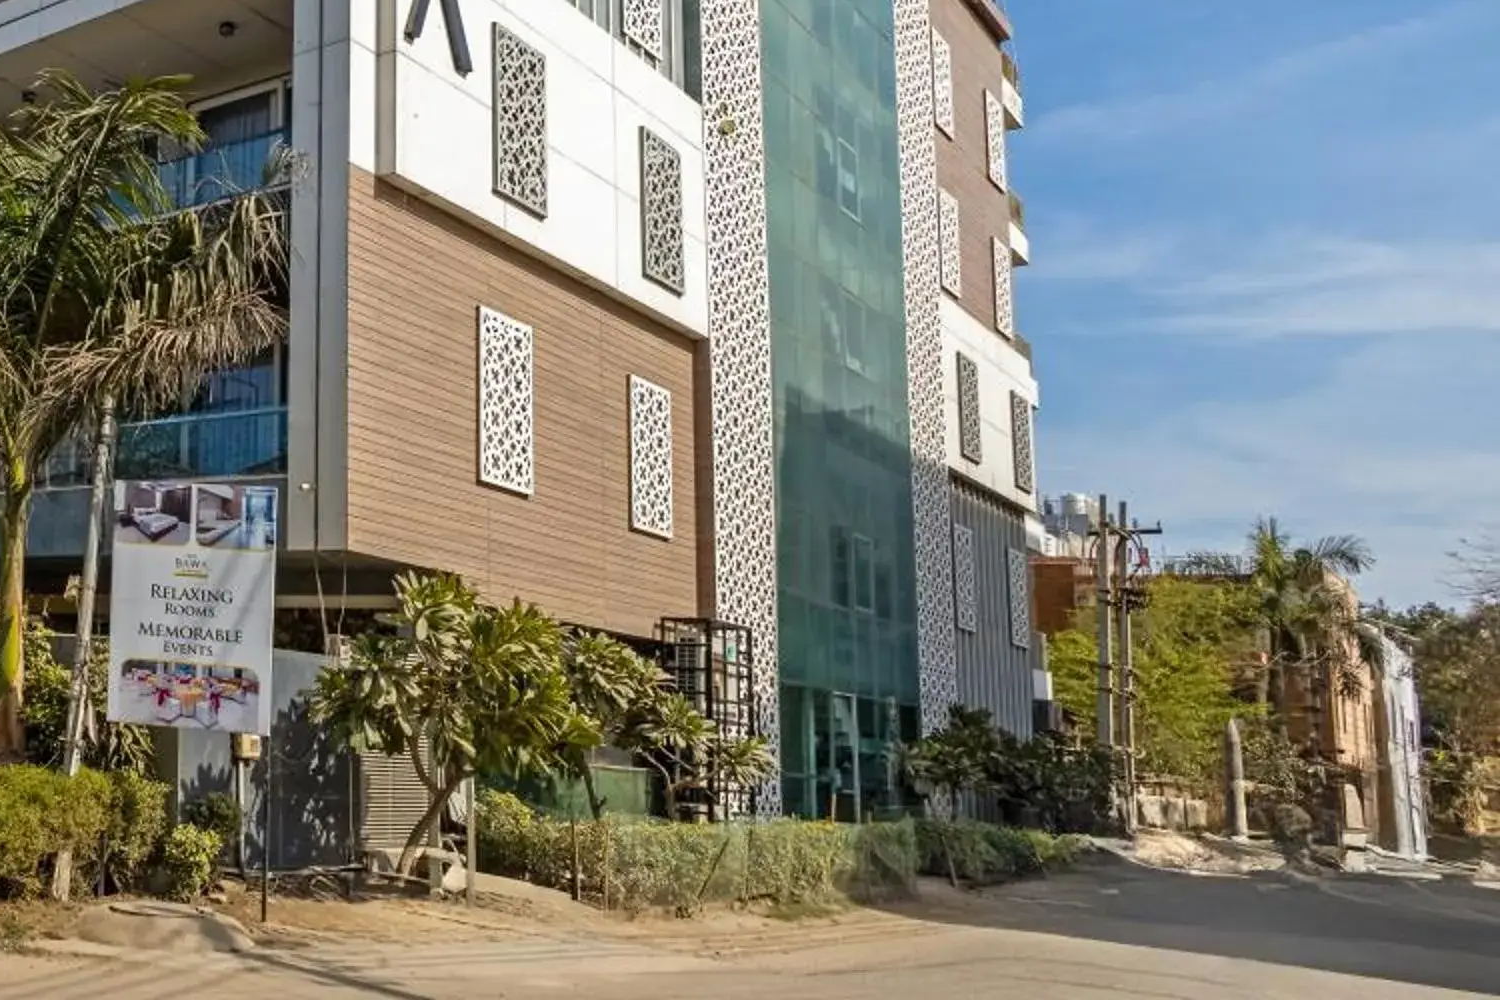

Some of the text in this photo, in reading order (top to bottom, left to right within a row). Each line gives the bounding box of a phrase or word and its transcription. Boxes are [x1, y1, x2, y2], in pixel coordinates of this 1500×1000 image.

[150, 583, 233, 604] RELAXING
[164, 602, 215, 618] ROOMS
[138, 622, 243, 643] MEMORABLE
[163, 640, 213, 657] EVENTS
